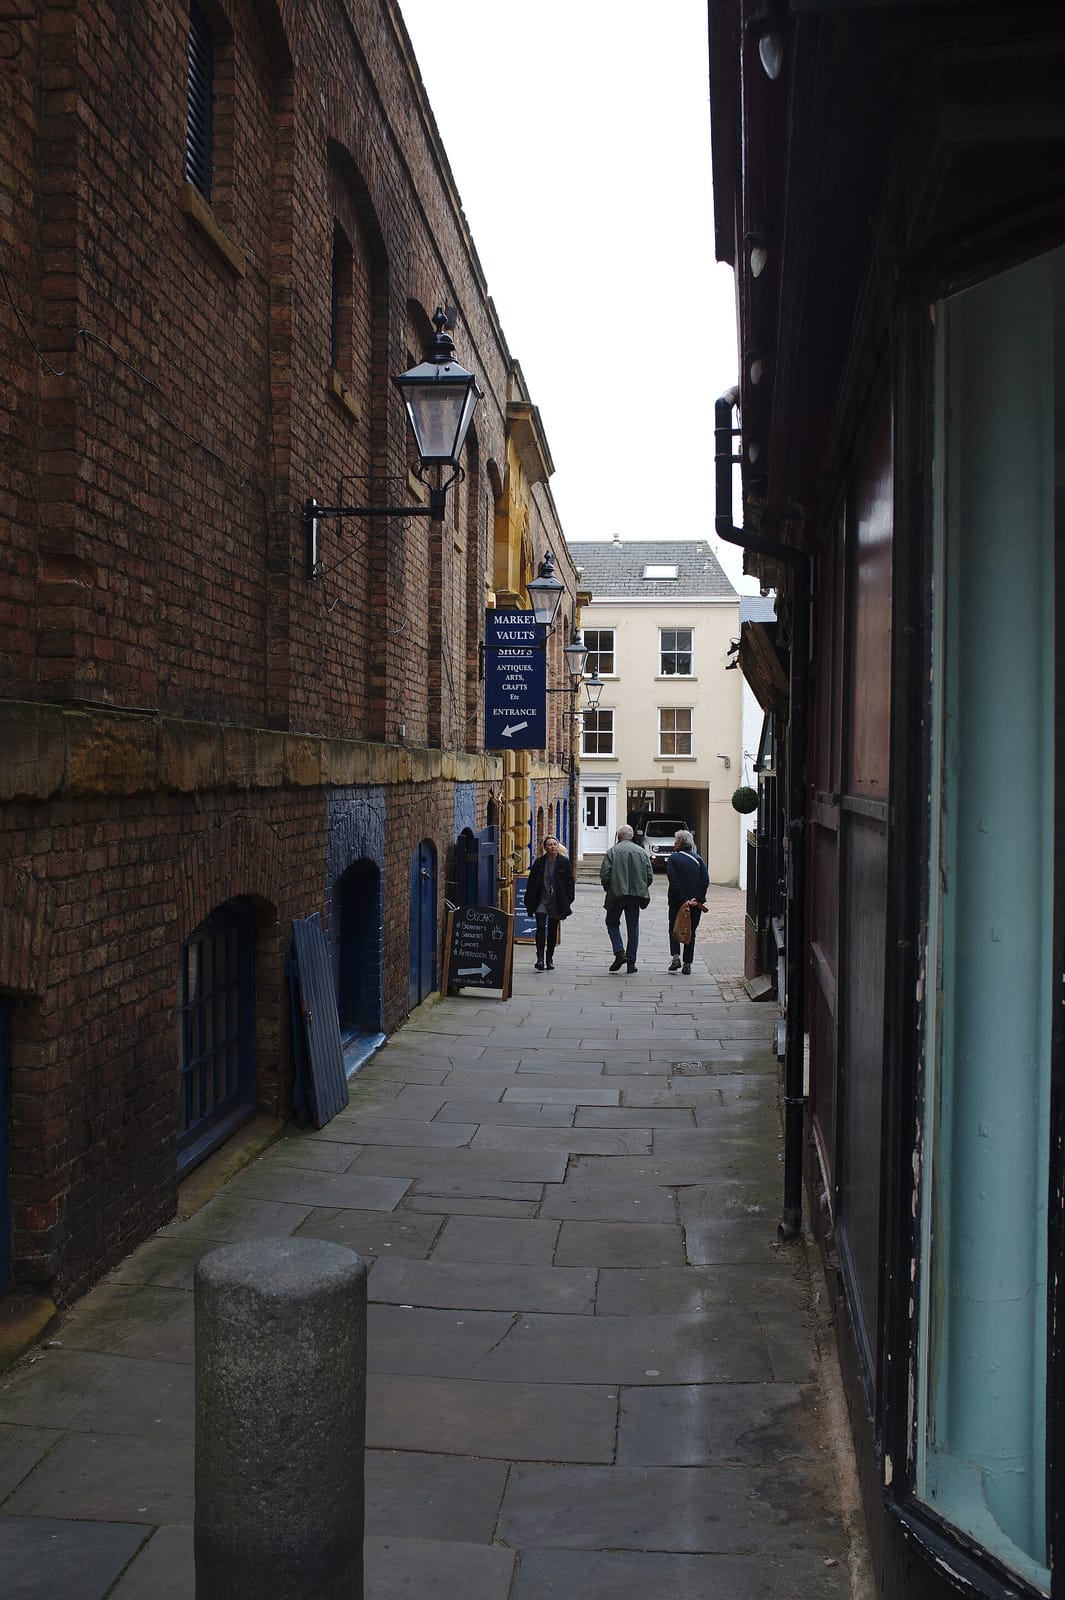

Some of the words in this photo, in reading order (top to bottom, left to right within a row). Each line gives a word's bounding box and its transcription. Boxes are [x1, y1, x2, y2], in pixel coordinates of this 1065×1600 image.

[494, 615, 536, 624] MARKET
[496, 631, 535, 640] VAULTS
[496, 664, 534, 672] ANTIQUES,
[493, 708, 537, 716] ENTRANCE
